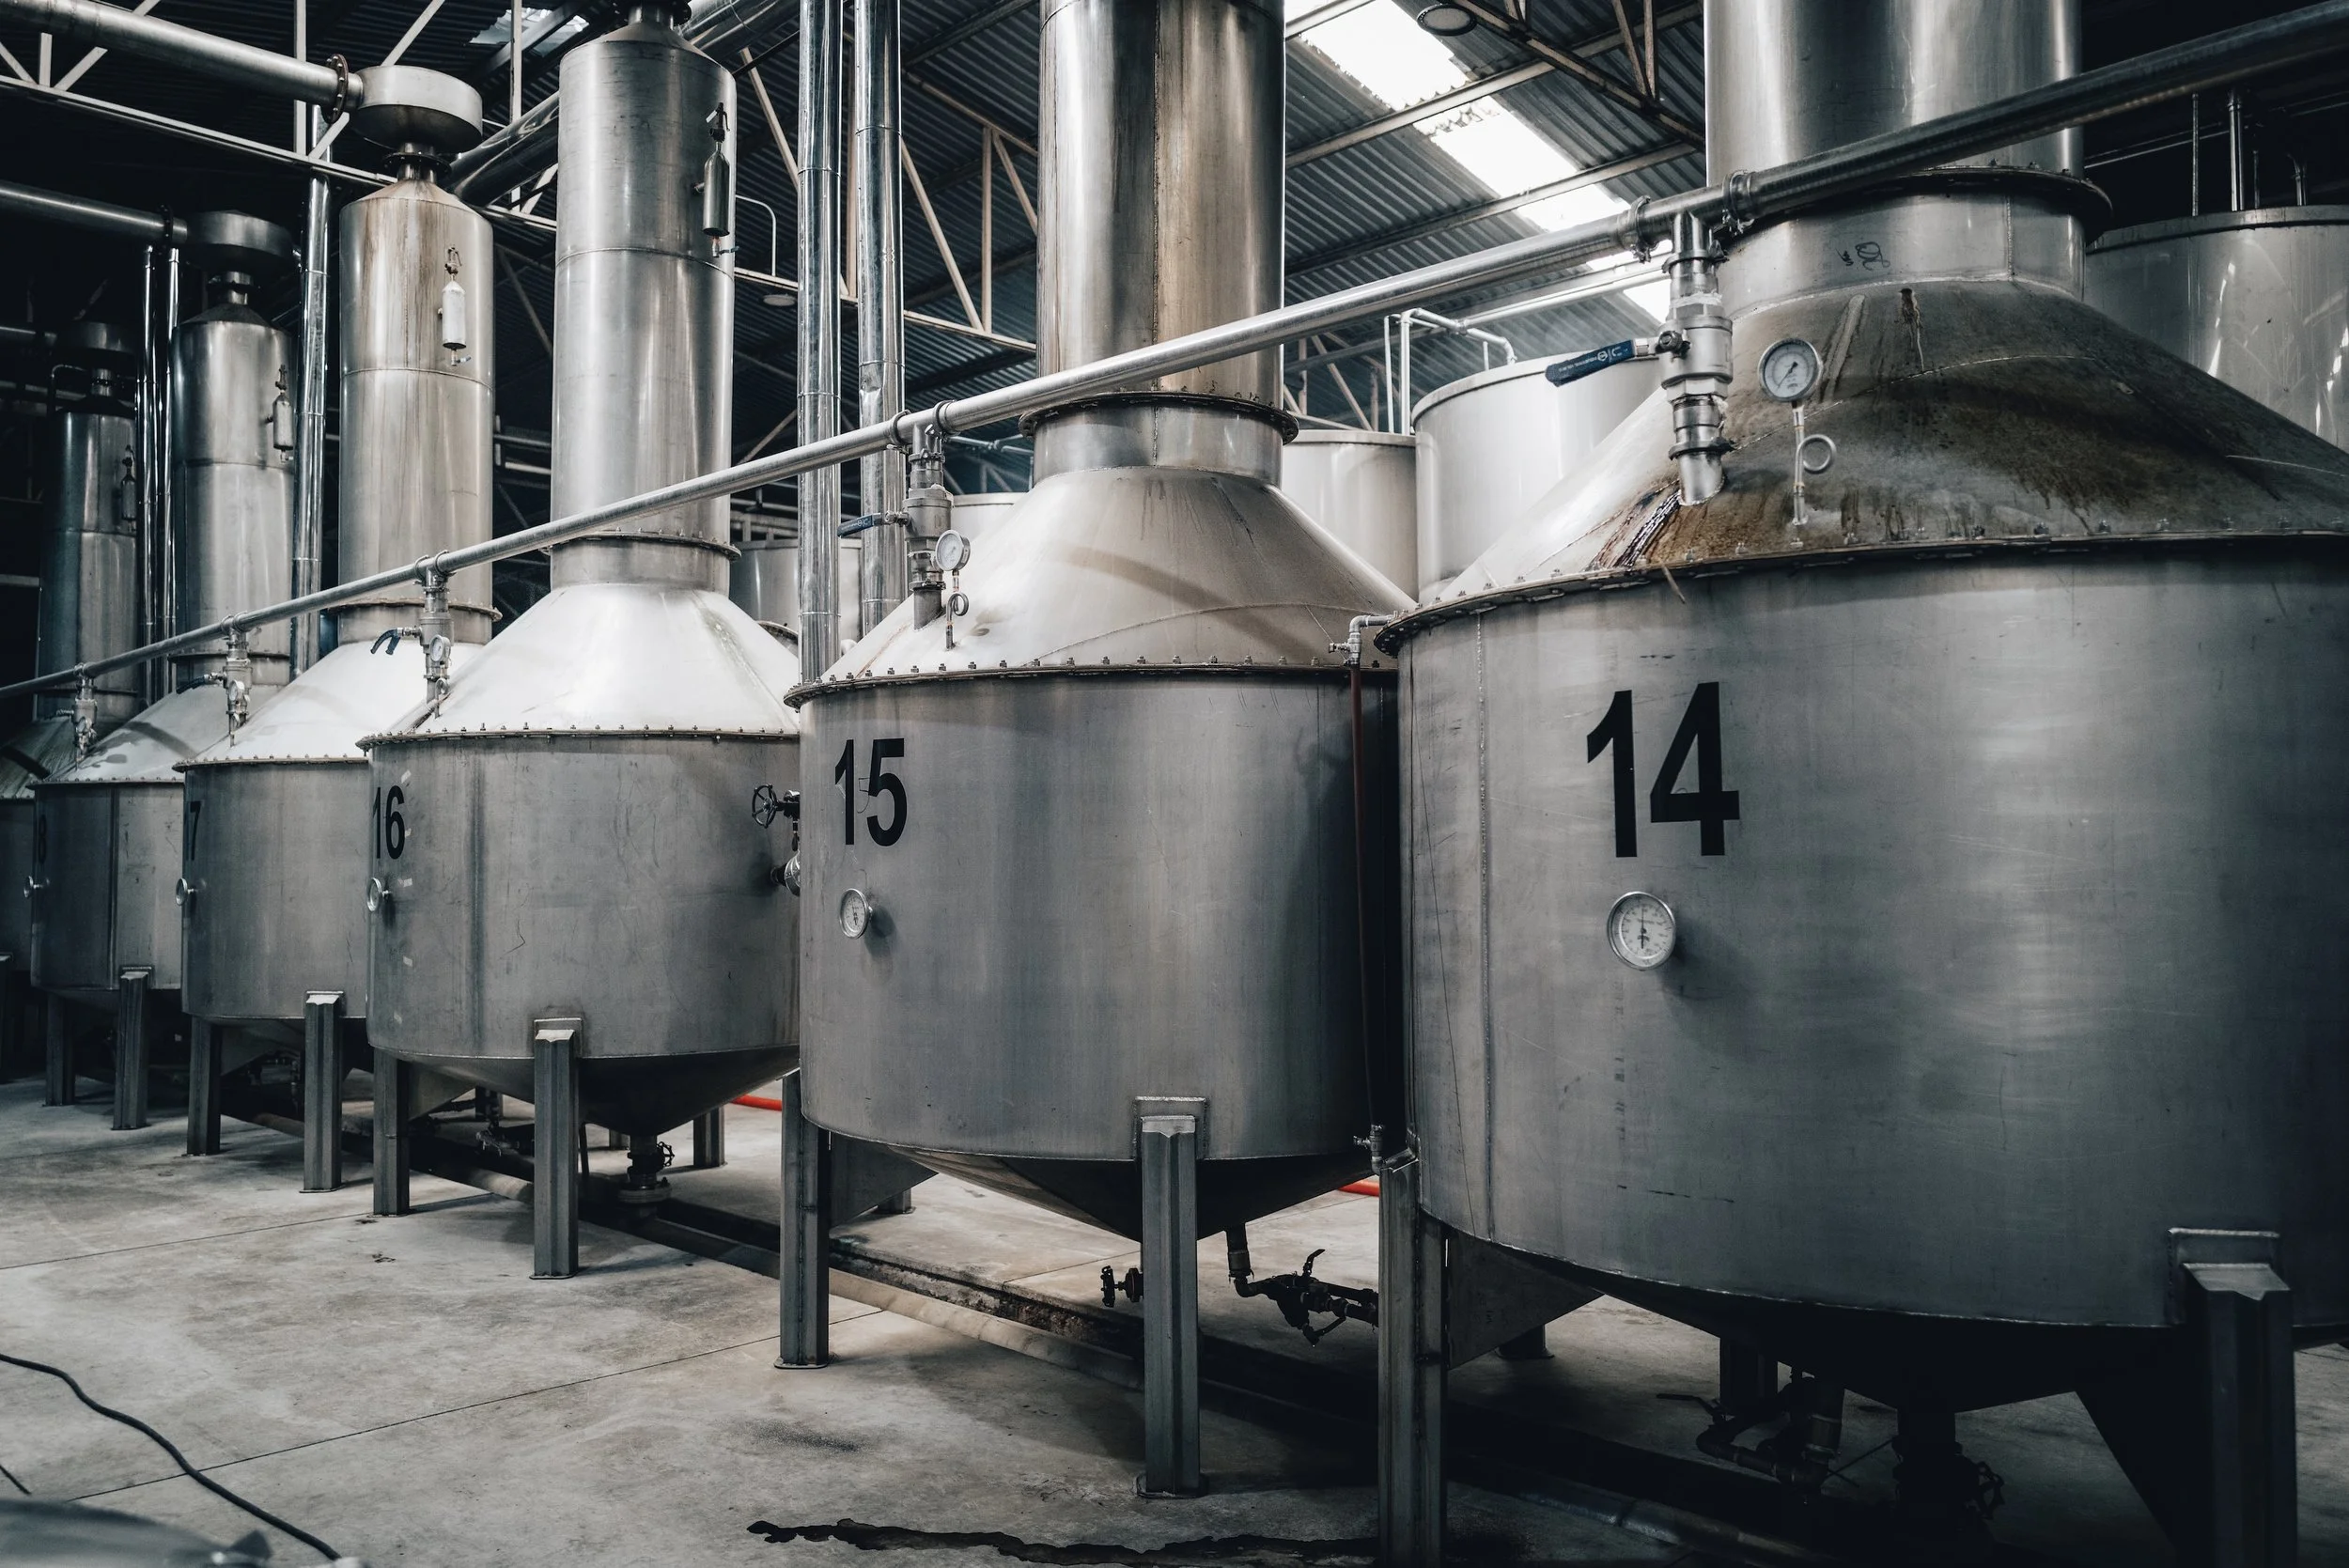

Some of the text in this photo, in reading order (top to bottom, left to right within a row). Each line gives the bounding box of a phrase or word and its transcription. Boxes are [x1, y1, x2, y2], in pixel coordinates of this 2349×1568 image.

[373, 785, 405, 860] 16
[835, 738, 907, 846] 15
[1587, 682, 1740, 857] 14
